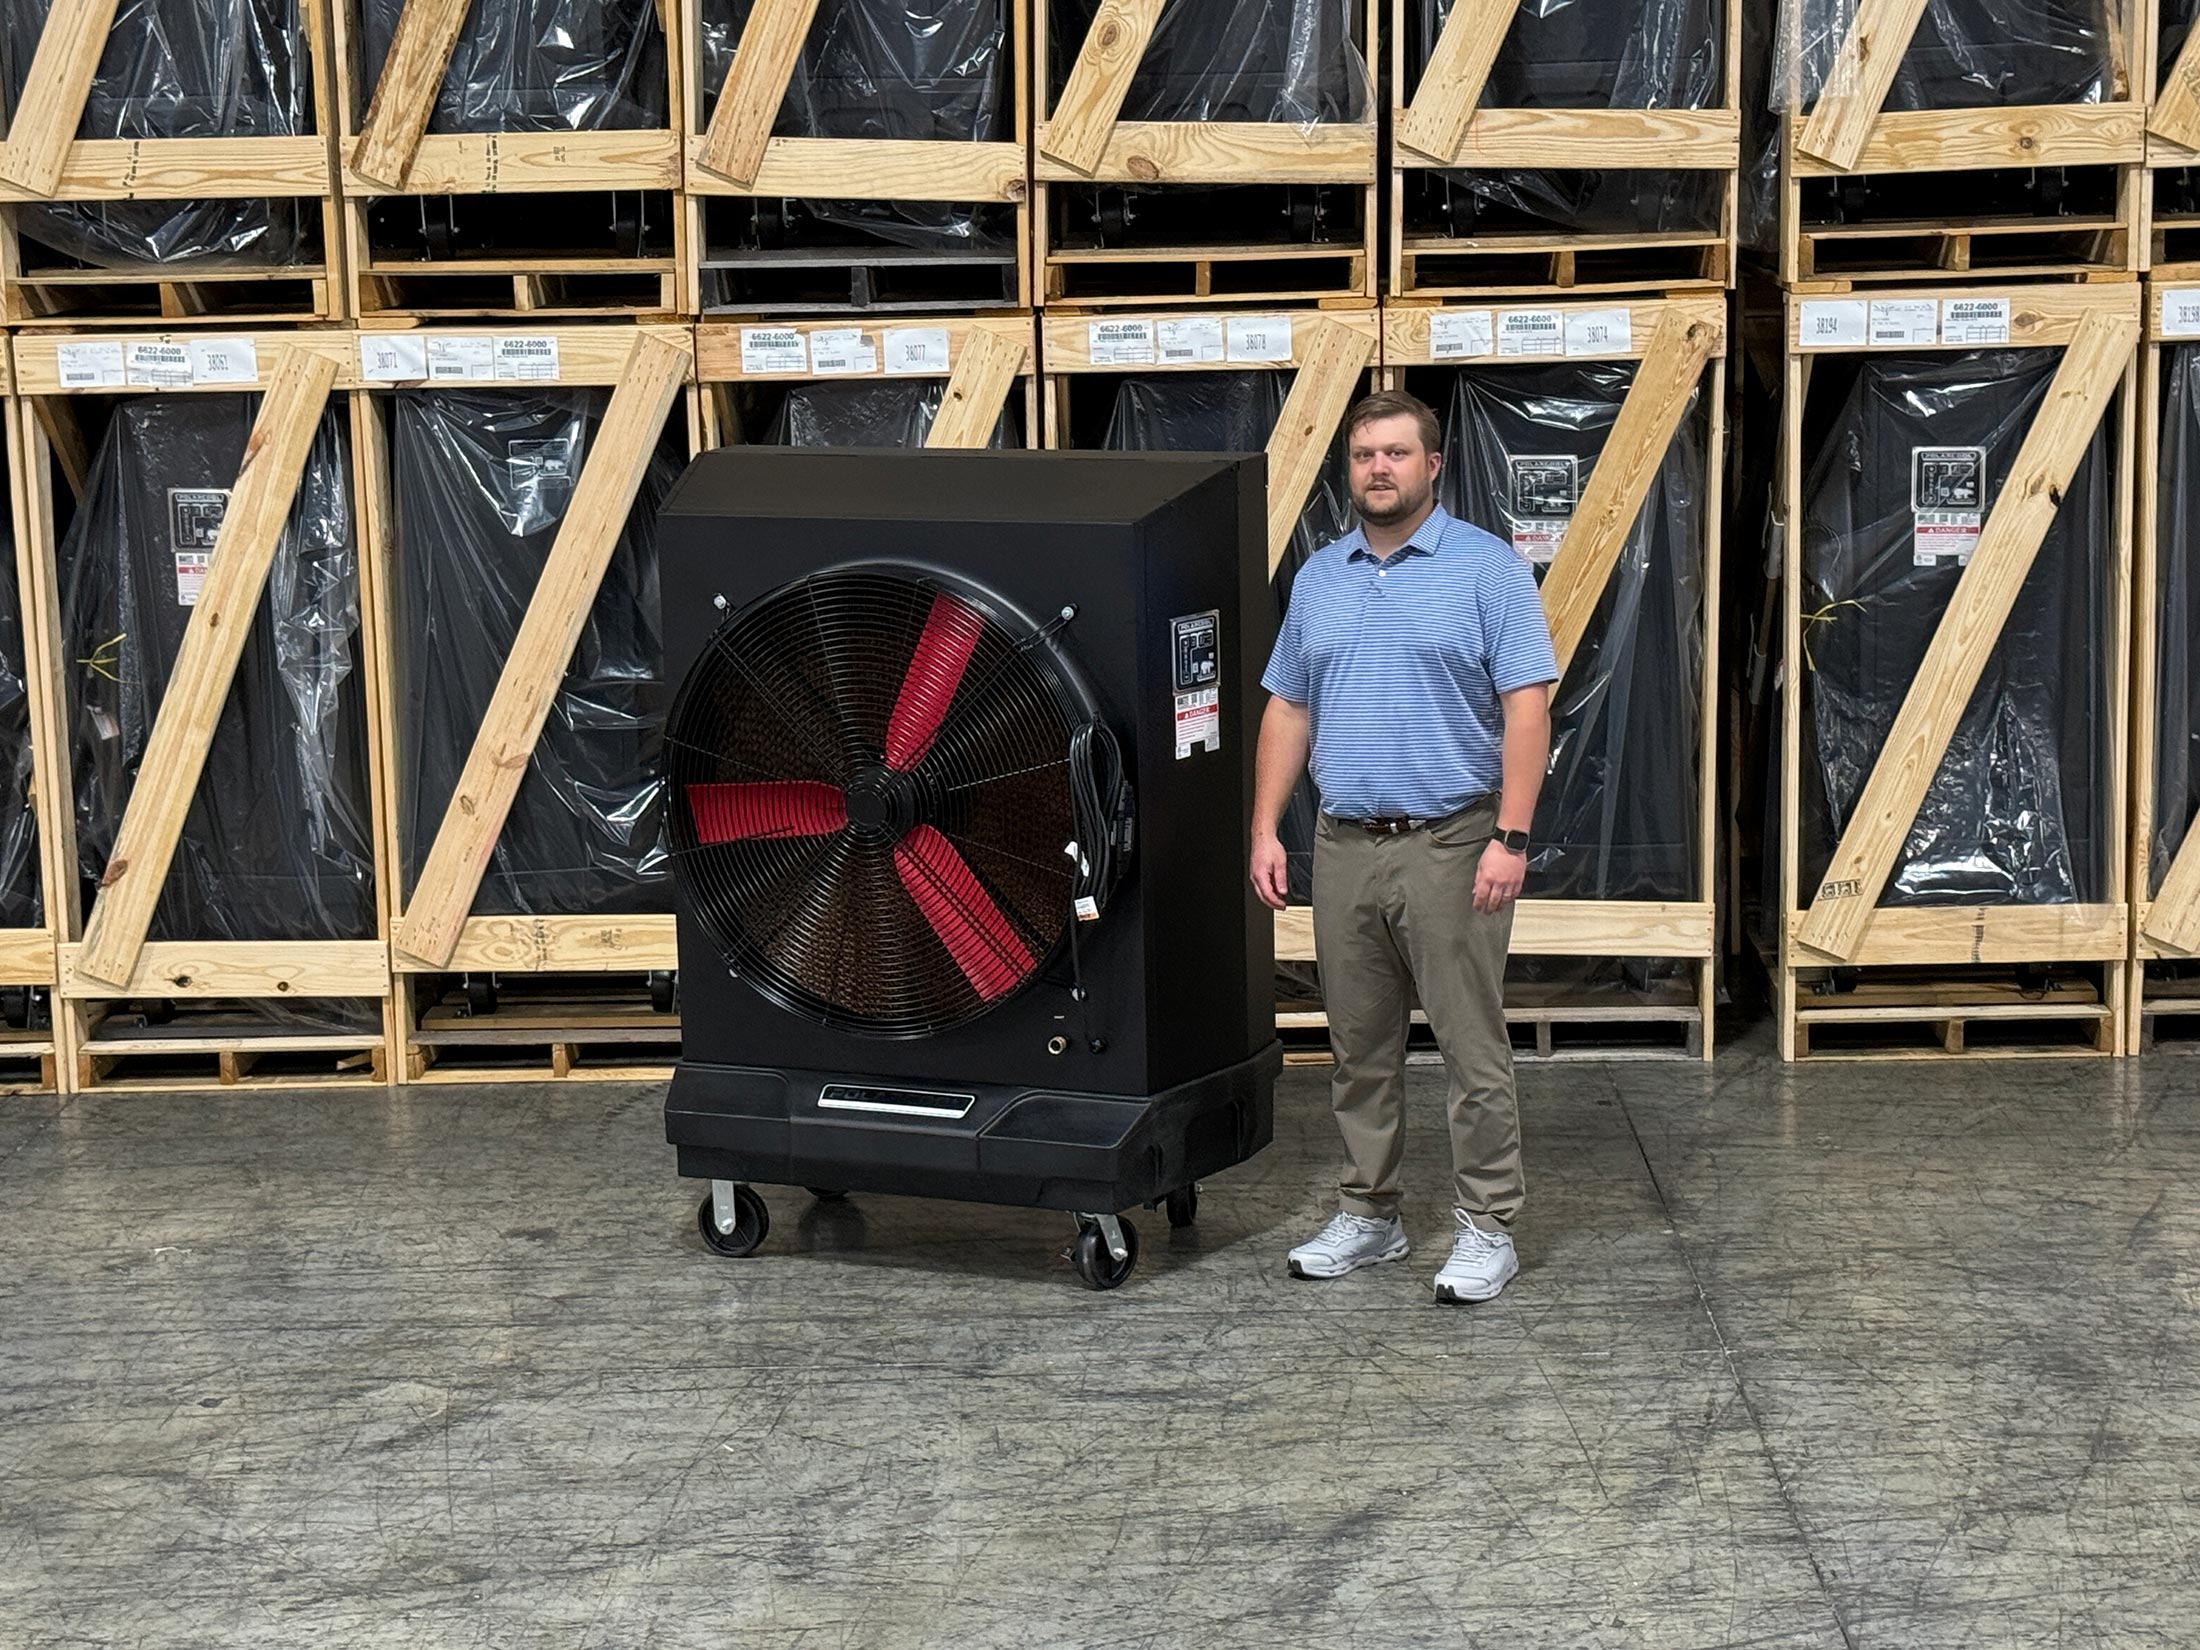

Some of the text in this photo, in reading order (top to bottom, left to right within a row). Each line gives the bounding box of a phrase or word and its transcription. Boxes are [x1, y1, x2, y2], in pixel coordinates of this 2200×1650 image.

[1953, 302, 1998, 311] 6622-6000
[1508, 314, 1552, 323] 6622-6000
[1099, 324, 1143, 333] 6622-6000
[751, 332, 795, 341] 6622-6000
[1586, 326, 1609, 344] 38074
[503, 340, 547, 348] 6622-6000
[1245, 333, 1267, 350] 38078
[138, 346, 182, 355] 6622-6000
[904, 344, 926, 361] 38077
